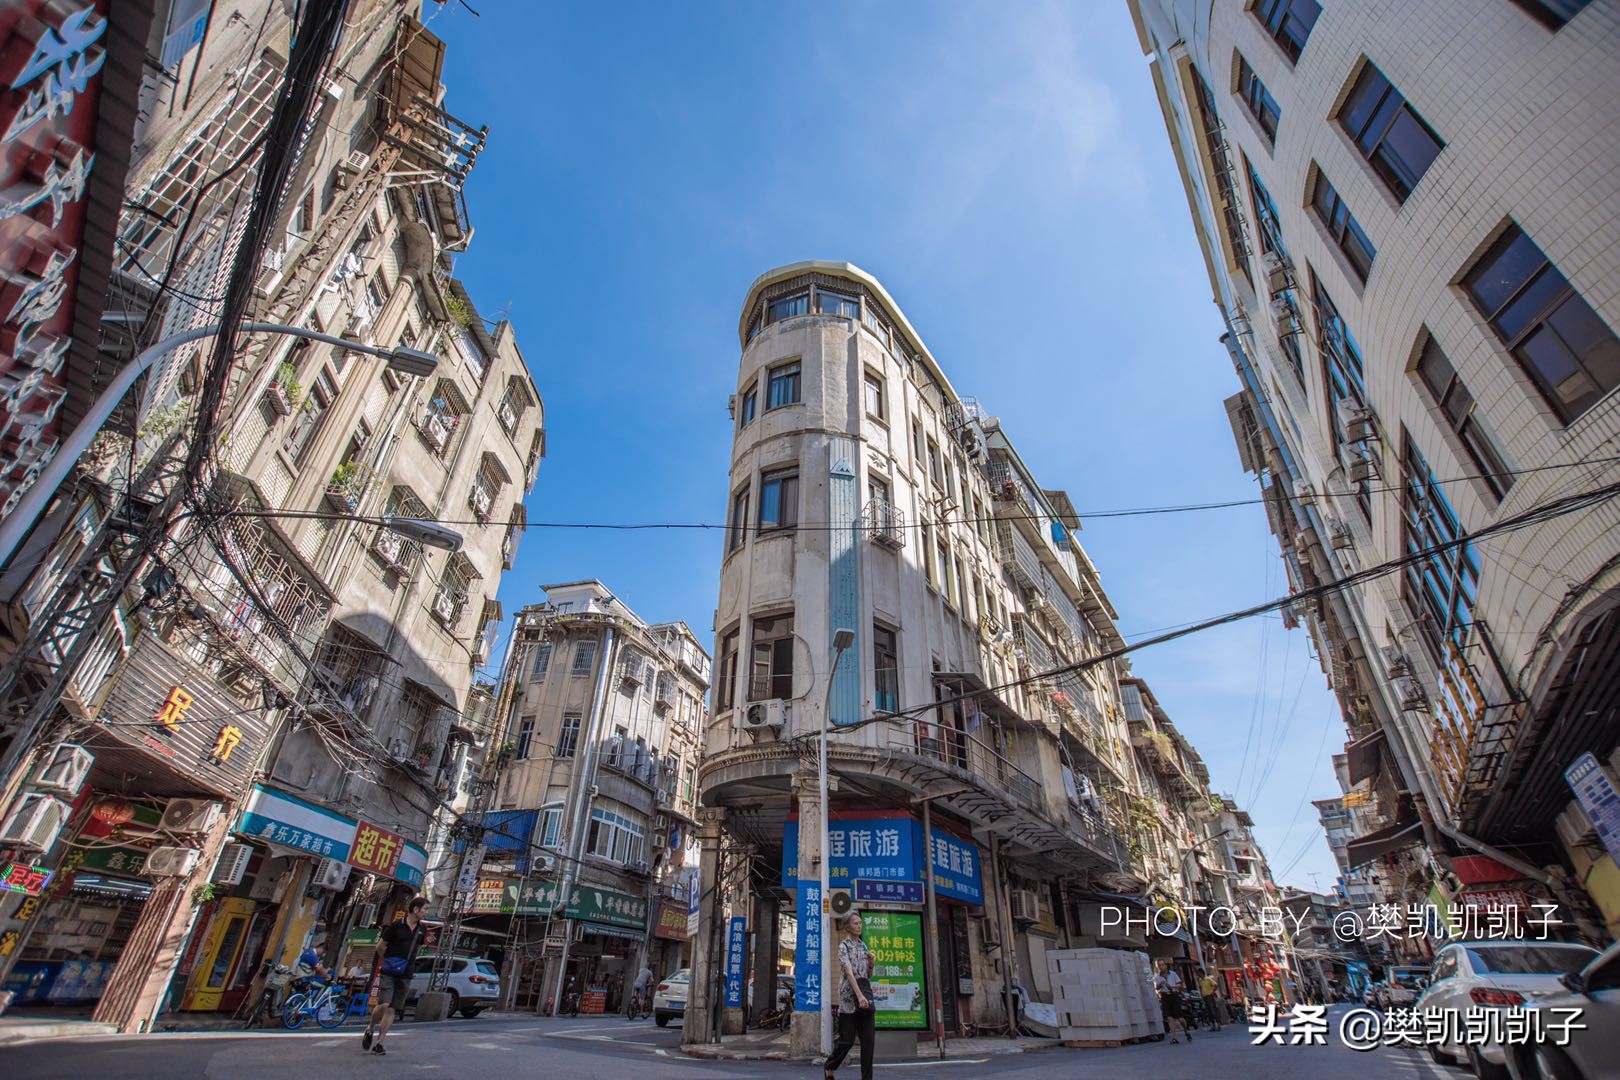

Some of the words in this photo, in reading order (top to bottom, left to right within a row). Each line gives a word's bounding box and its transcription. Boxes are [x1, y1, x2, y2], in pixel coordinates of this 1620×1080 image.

[155, 685, 243, 762] 足疗
[262, 821, 334, 856] 鑫乐万家超市
[352, 826, 397, 870] 超市
[5, 864, 47, 894] 足疗
[869, 935, 915, 949] 朴朴超市
[805, 974, 820, 1005] 代定
